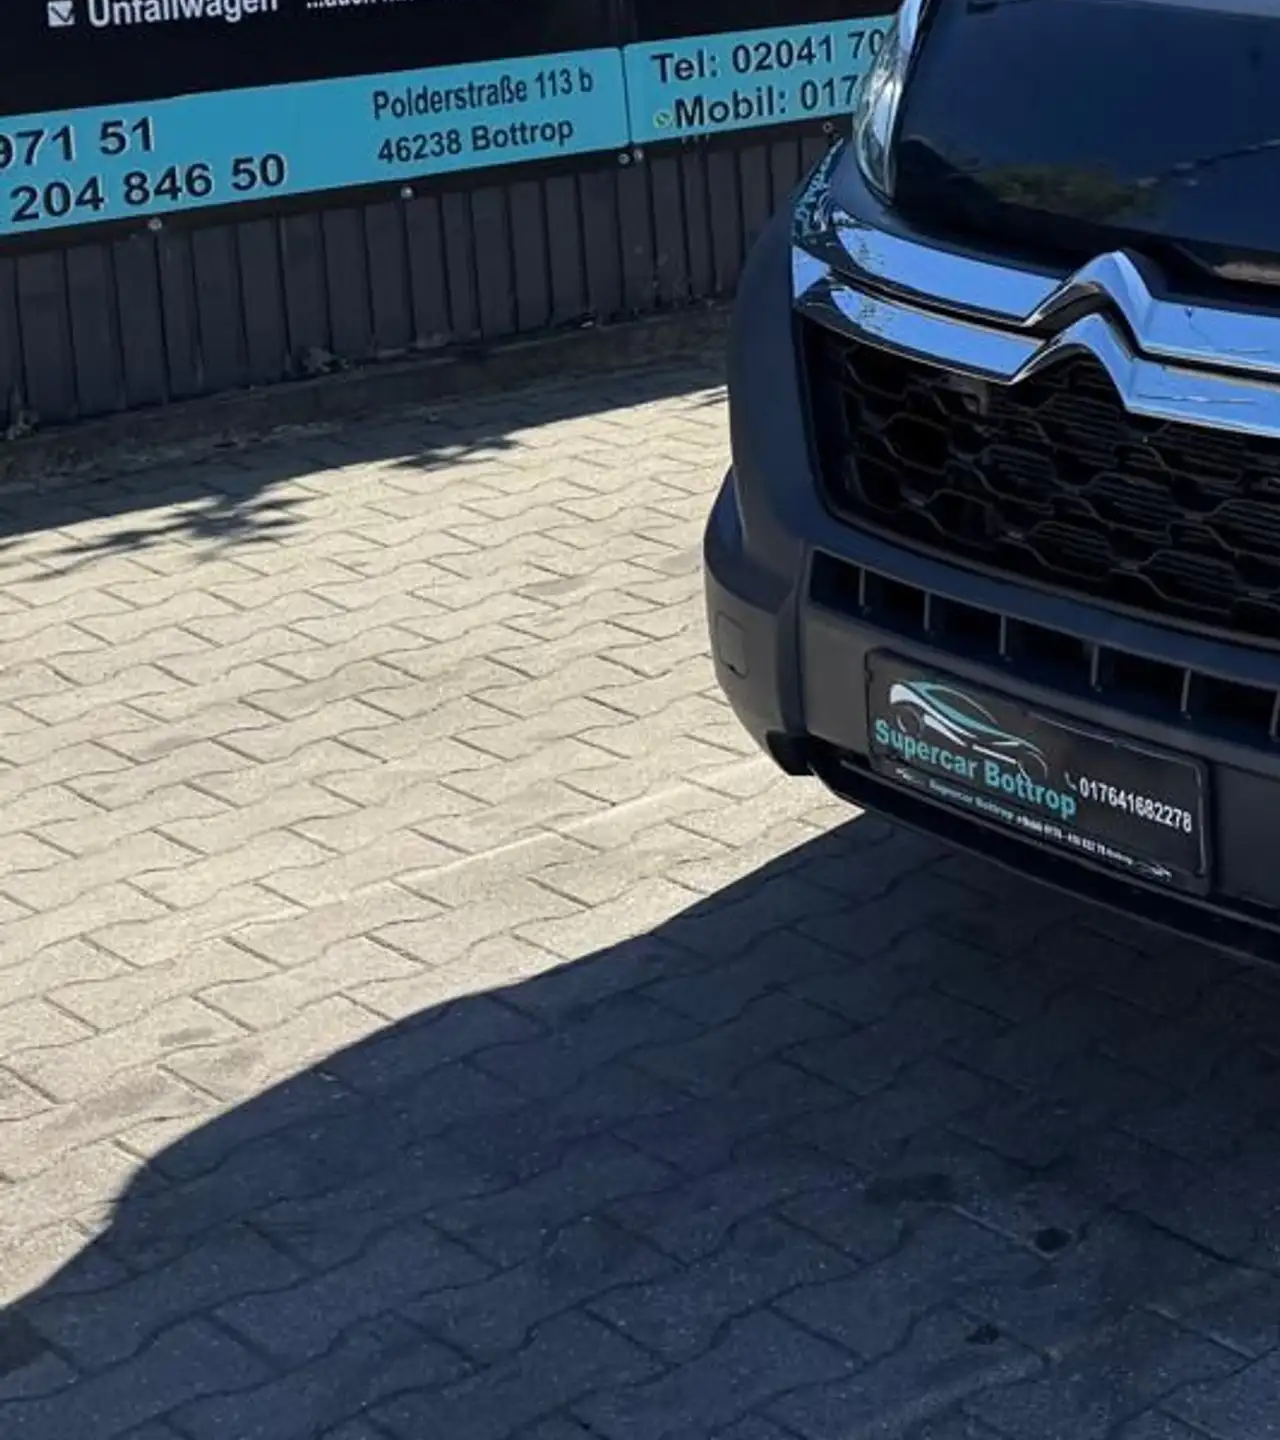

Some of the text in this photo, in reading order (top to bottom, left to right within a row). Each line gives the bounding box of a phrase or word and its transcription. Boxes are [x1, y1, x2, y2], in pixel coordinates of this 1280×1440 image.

[651, 48, 720, 84] Tel:
[731, 35, 833, 74] 02041
[372, 66, 594, 120] Polderstraße 113 b
[674, 84, 788, 130] Mobil:
[99, 116, 154, 156] 51
[378, 119, 574, 164] 46238 Bottrop
[9, 154, 286, 222] 204 846 50
[874, 718, 1078, 821] Supercar Bottrop
